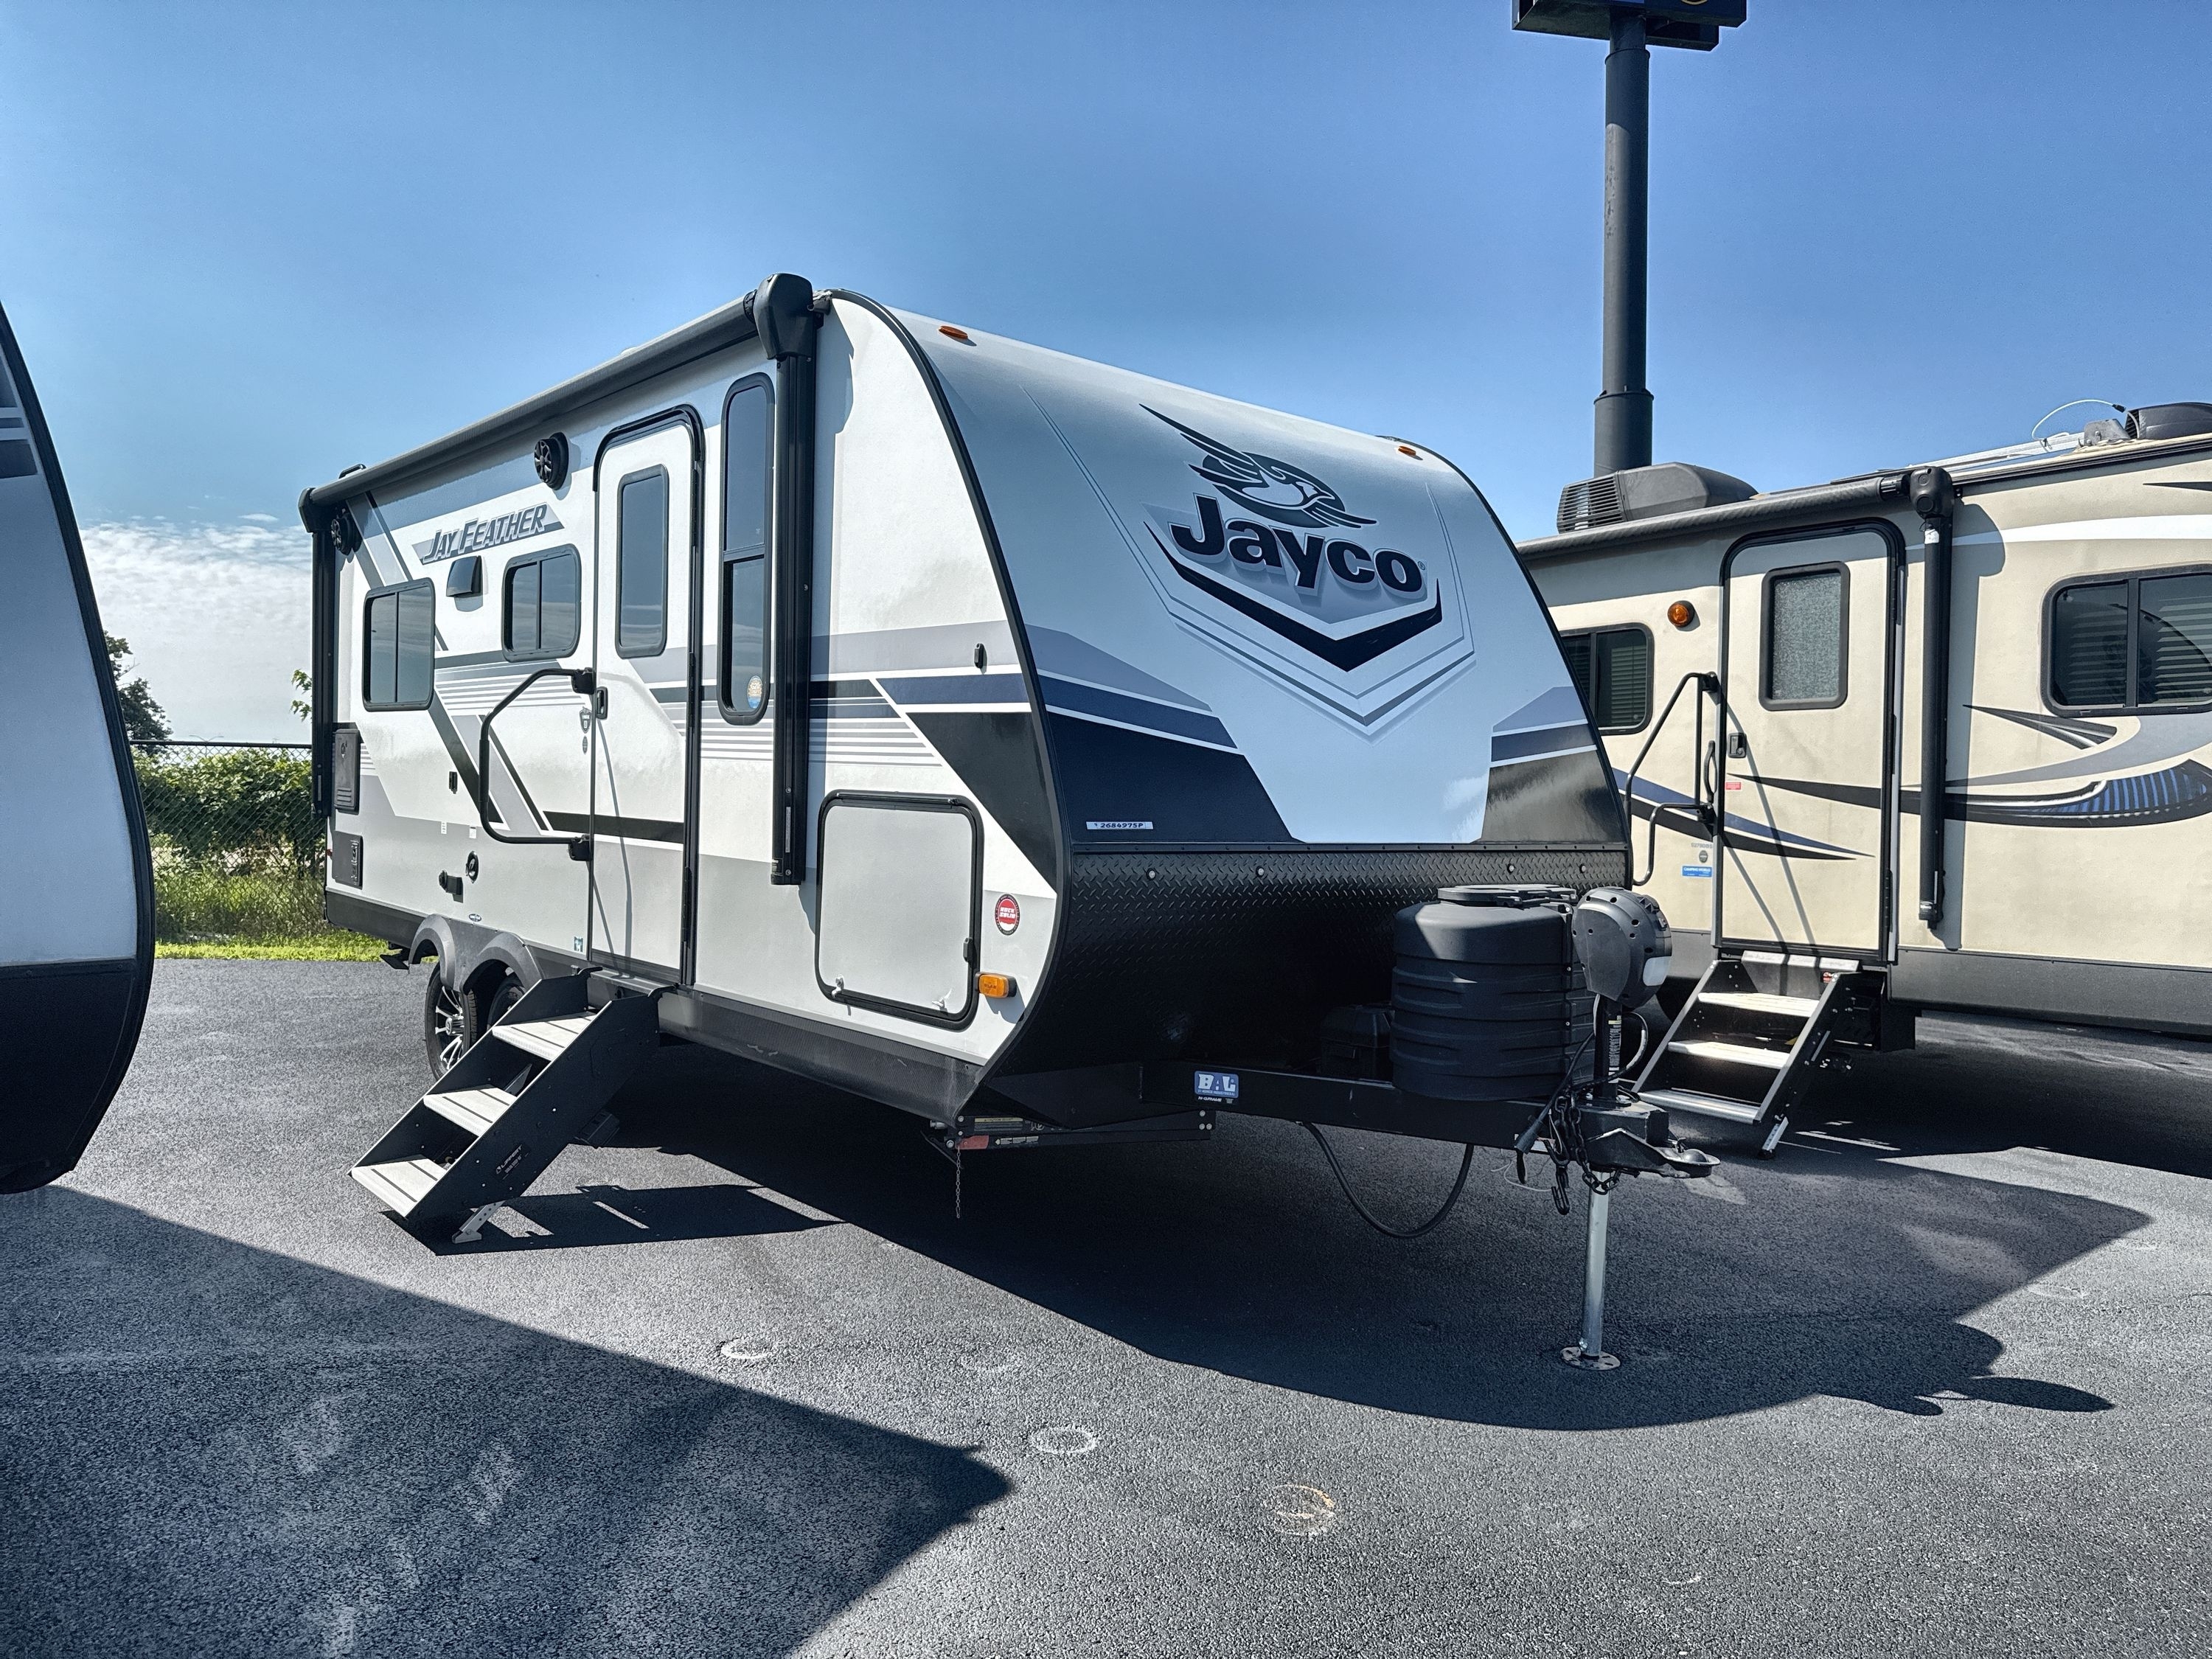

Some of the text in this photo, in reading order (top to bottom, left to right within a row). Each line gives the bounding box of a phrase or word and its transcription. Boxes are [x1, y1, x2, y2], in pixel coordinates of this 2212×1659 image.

[424, 502, 548, 562] JAY FEATHER
[1168, 493, 1425, 594] Jayco
[1198, 1074, 1236, 1092] BAL
